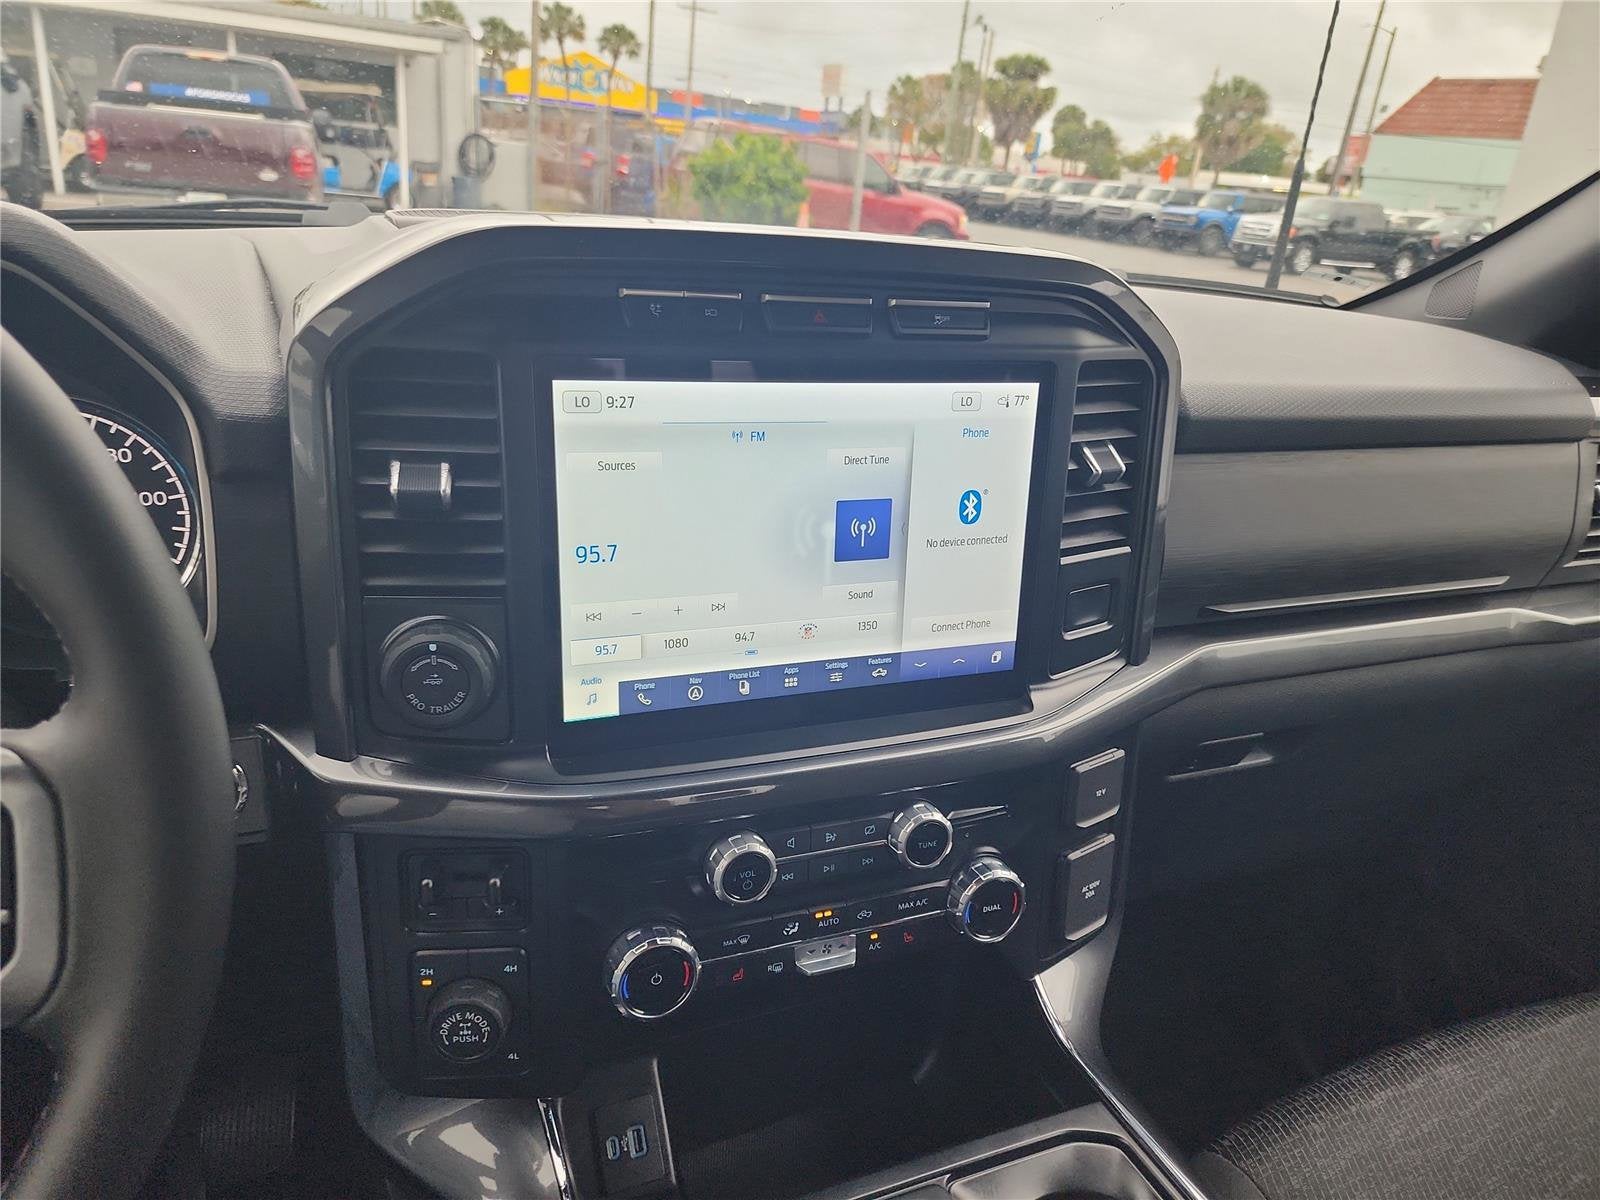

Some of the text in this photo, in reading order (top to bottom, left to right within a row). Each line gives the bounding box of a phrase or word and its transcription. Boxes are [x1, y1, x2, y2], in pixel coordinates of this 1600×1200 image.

[574, 396, 591, 409] LO
[605, 395, 636, 409] 9:27
[960, 396, 973, 408] LO
[750, 431, 766, 442] FM
[962, 427, 990, 439] Phone
[843, 454, 890, 466] Direct Tune
[597, 460, 636, 472] Sources
[926, 534, 1009, 549] No device connected
[575, 543, 618, 564] 95.7
[847, 589, 874, 600] Sound
[857, 620, 879, 631] 1350
[931, 618, 991, 633] Connect Phone
[734, 631, 756, 643] 94.7
[663, 637, 690, 649] 1080
[594, 643, 618, 656] 95.7
[825, 660, 849, 671] Settings
[868, 656, 893, 665] Features
[729, 670, 761, 680] Phone List
[783, 666, 800, 675] Apps
[580, 676, 602, 686] Audio
[633, 681, 656, 691] Phone
[689, 676, 703, 685] Nav
[406, 691, 467, 714] PRO TRAILER
[917, 840, 938, 849] TUNE
[739, 870, 757, 879] VOL
[897, 898, 929, 910] MAX A/C
[982, 903, 1002, 913] DUAL
[817, 917, 840, 928] AUTO
[722, 939, 738, 947] MAX
[868, 942, 882, 951] A/C
[419, 968, 434, 976] 2H
[503, 964, 518, 973] 4H
[439, 1011, 491, 1036] DRIVE MODE
[452, 1034, 479, 1044] PUSH
[507, 1052, 520, 1060] 4L
